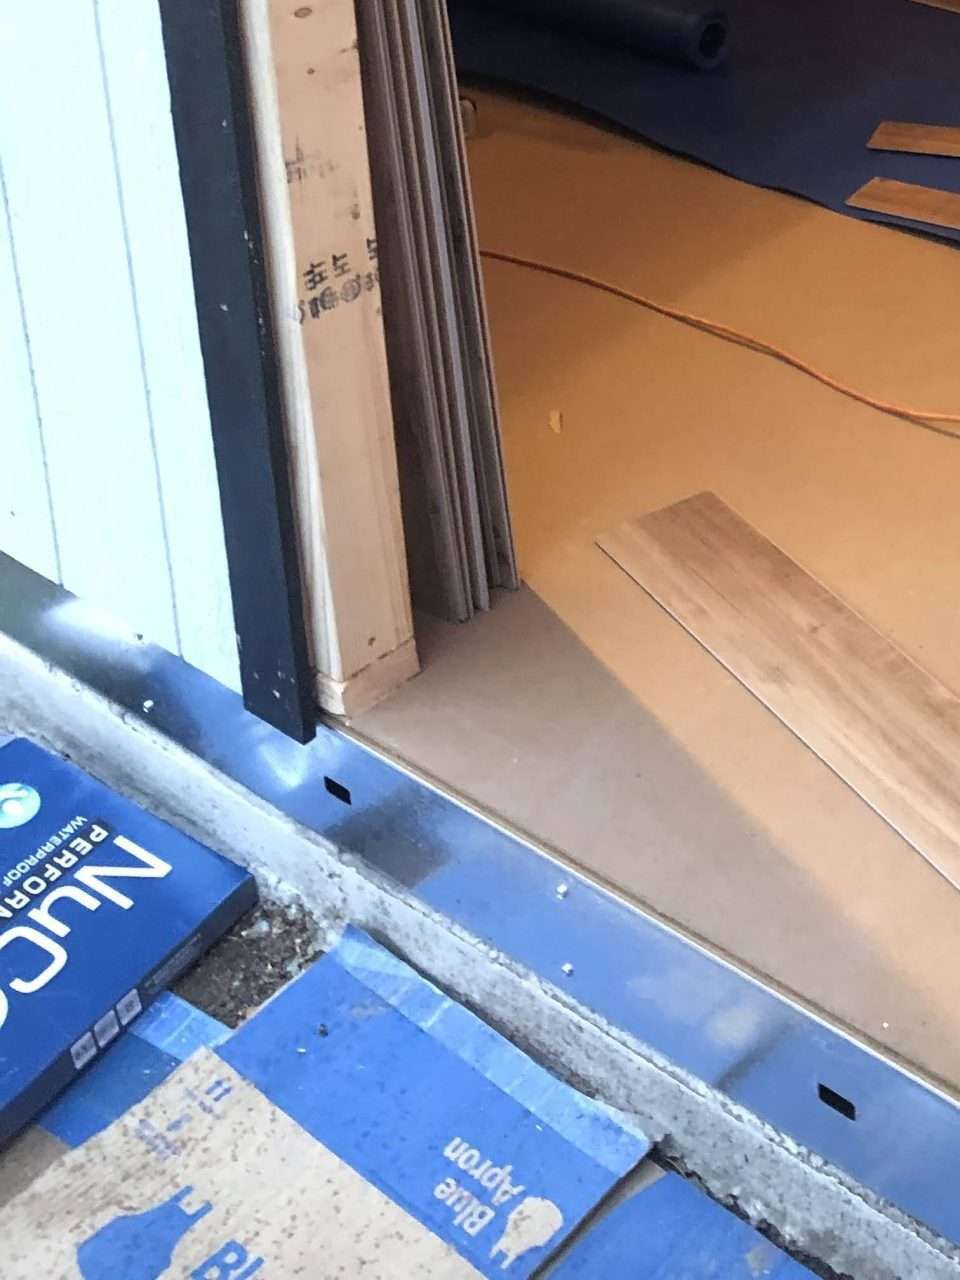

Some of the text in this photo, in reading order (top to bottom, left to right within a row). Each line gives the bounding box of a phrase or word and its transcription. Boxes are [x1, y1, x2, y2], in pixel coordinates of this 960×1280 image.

[2, 815, 88, 887] WATERPROOF
[433, 1177, 496, 1237] Blue
[443, 1136, 526, 1207] Apron
